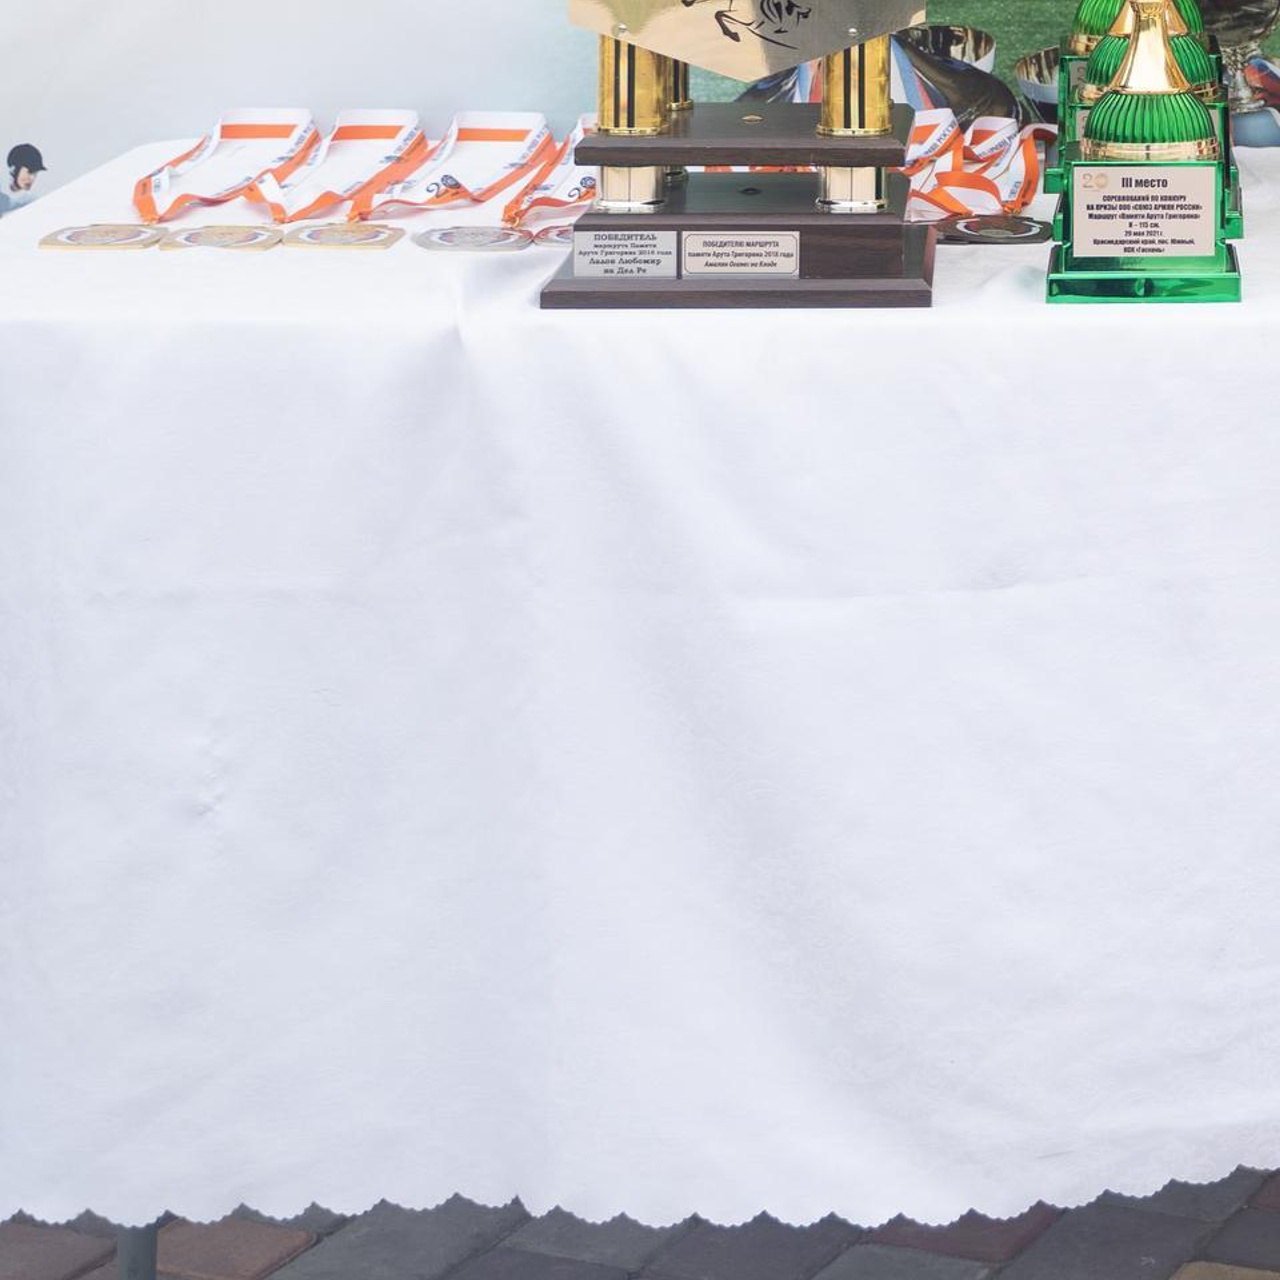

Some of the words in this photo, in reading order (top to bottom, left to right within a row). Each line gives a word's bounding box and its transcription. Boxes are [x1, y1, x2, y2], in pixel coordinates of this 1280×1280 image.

[1121, 177, 1132, 188] III
[1134, 178, 1169, 189] место
[594, 233, 657, 242] ПОБЕДИТЕЛЬ
